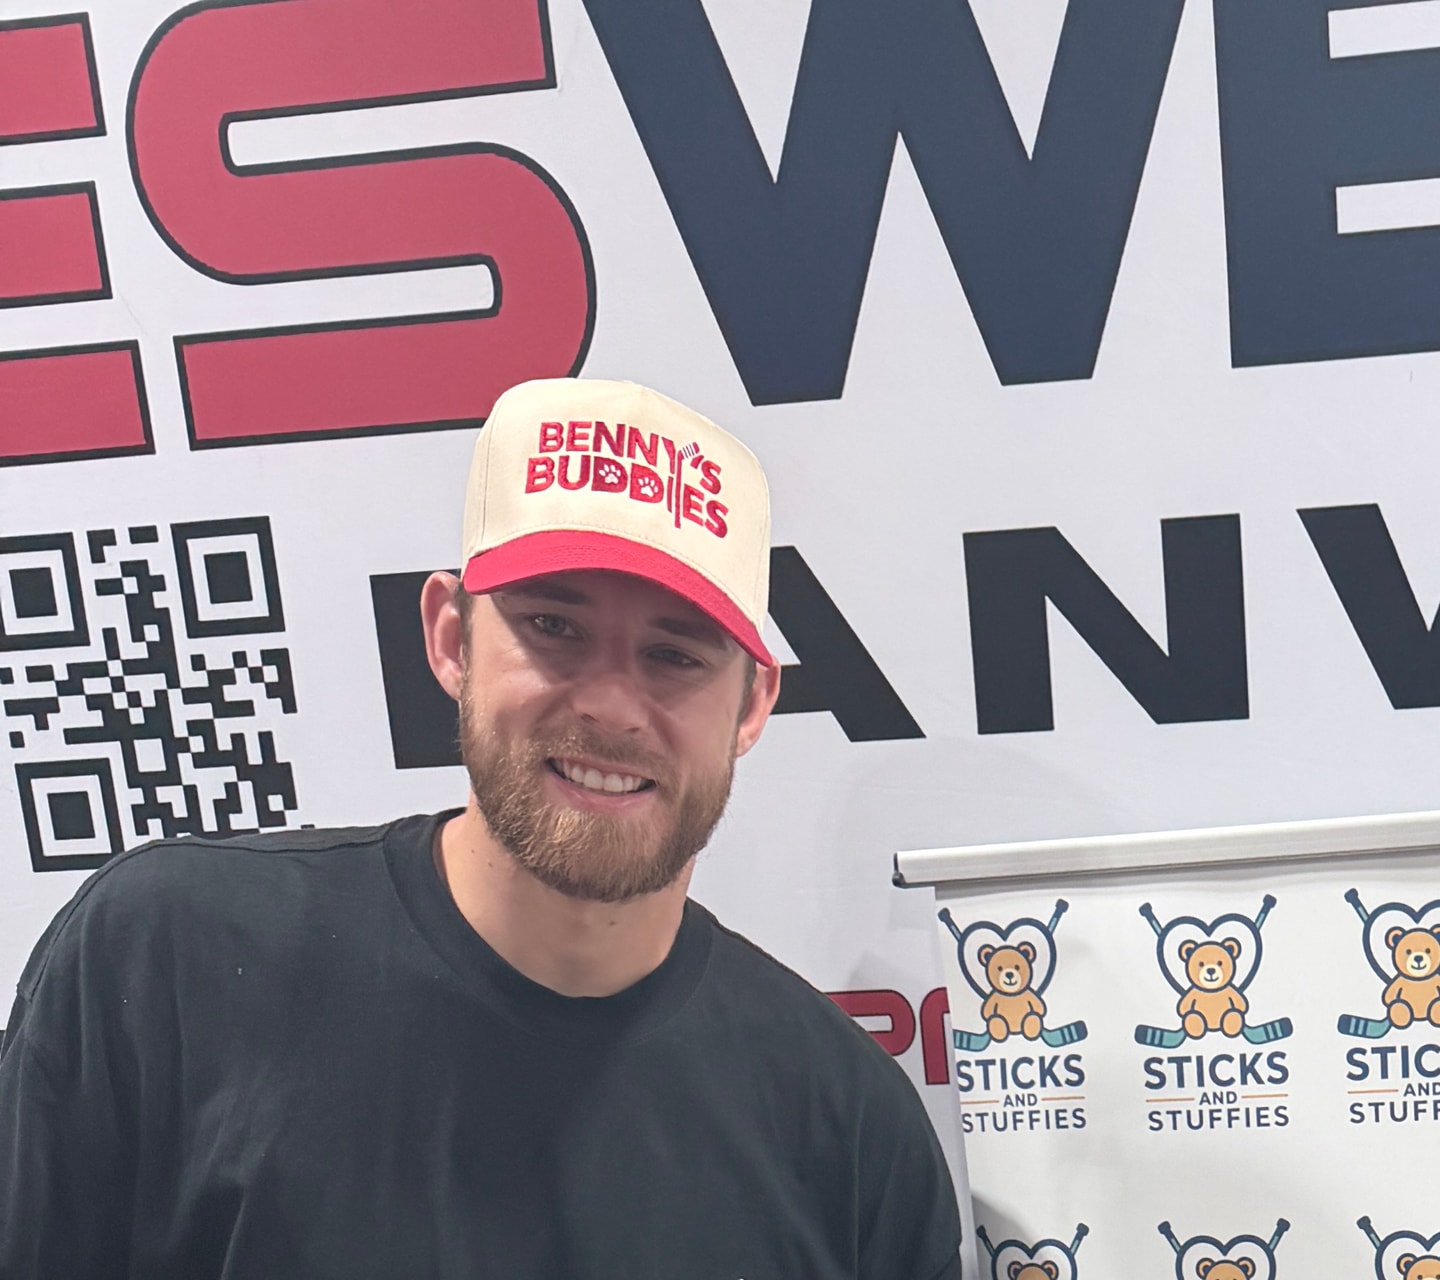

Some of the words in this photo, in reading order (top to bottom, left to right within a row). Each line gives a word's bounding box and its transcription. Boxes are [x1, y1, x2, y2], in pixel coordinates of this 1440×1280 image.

[538, 420, 722, 495] BENNY'S
[524, 454, 729, 539] BUDDIES
[957, 1054, 1085, 1092] STICKS
[1143, 1051, 1289, 1090] STICKS
[1003, 1093, 1038, 1108] AND
[1199, 1091, 1238, 1106] AND
[962, 1109, 1087, 1133] STUFFIES
[1148, 1106, 1289, 1133] STUFFIES
